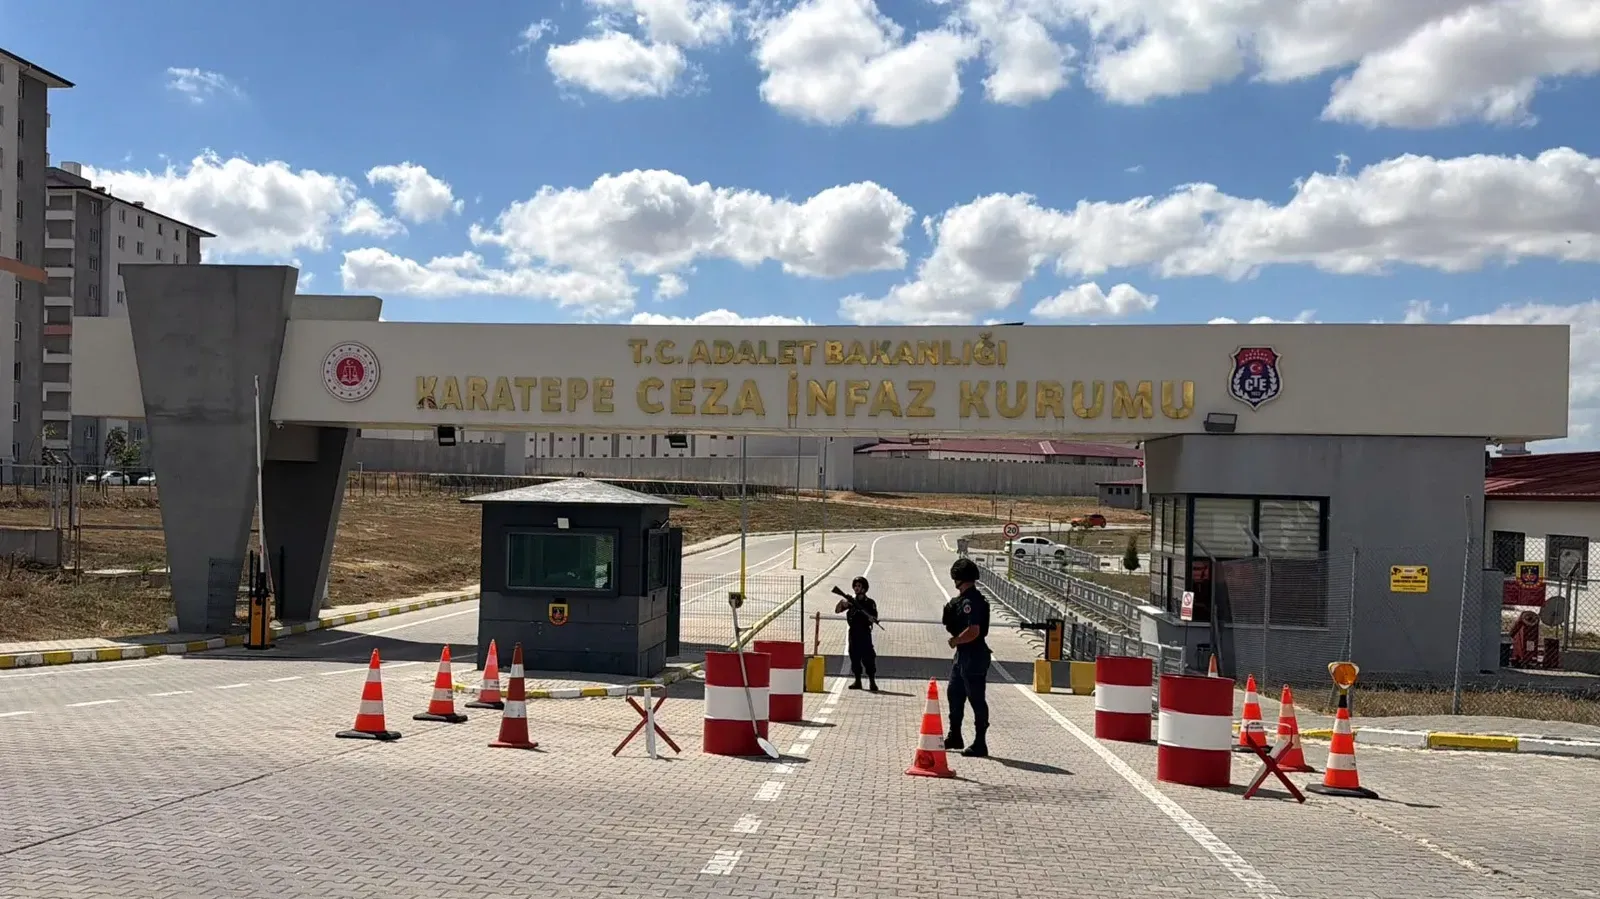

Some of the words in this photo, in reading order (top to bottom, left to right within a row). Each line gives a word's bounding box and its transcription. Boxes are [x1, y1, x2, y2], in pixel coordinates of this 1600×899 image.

[627, 338, 683, 364] T.C.
[688, 339, 817, 365] ADALET
[825, 331, 1008, 366] BAKANLIĞI
[415, 375, 615, 413] KARATEPE
[636, 377, 766, 416] CEZA
[787, 369, 936, 417] İNFAZ
[959, 379, 1195, 419] KURUMU
[1007, 526, 1016, 534] 20
